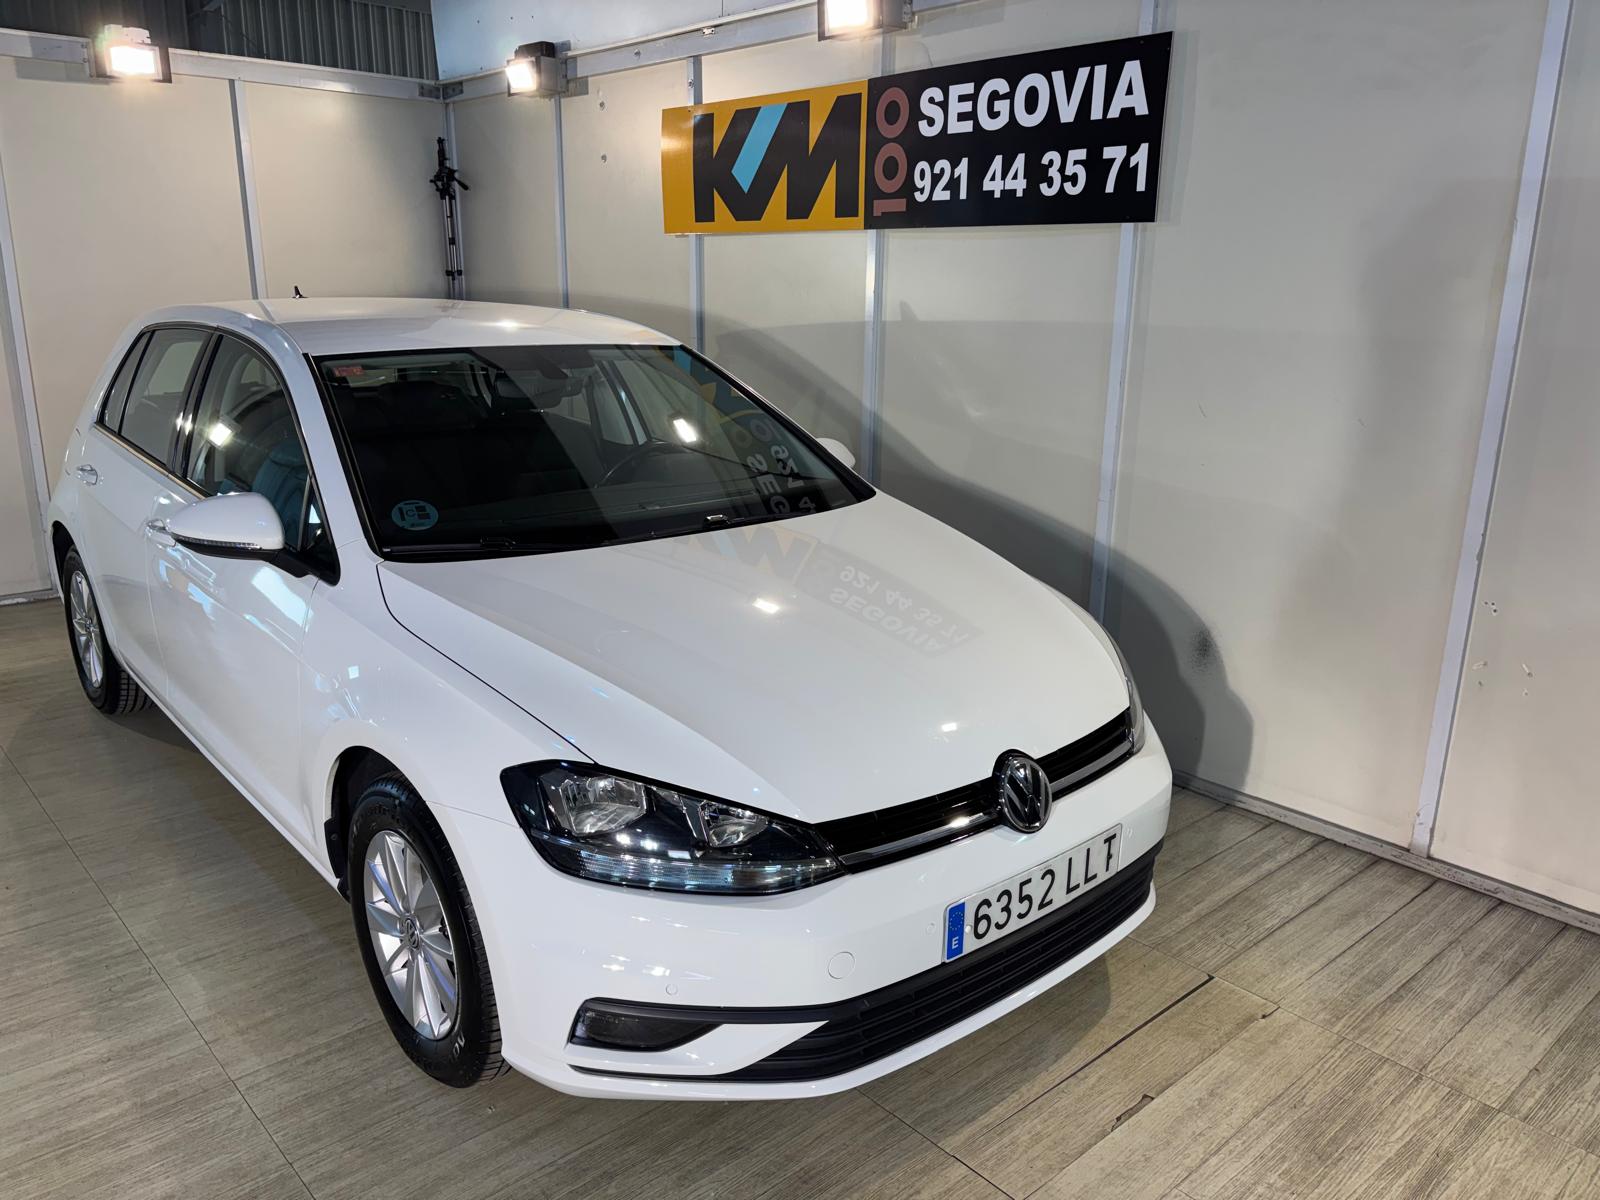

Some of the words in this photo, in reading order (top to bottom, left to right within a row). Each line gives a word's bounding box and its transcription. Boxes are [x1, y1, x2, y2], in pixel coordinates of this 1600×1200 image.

[918, 59, 1149, 138] SEGOVIA
[693, 92, 863, 223] KM
[873, 86, 910, 217] 100
[913, 156, 968, 203] 921
[983, 152, 1027, 198] 44
[1039, 147, 1087, 197] 35
[1102, 142, 1149, 194] 71
[973, 868, 1056, 940] 6352
[1065, 833, 1117, 896] LLT
[951, 936, 959, 949] E
